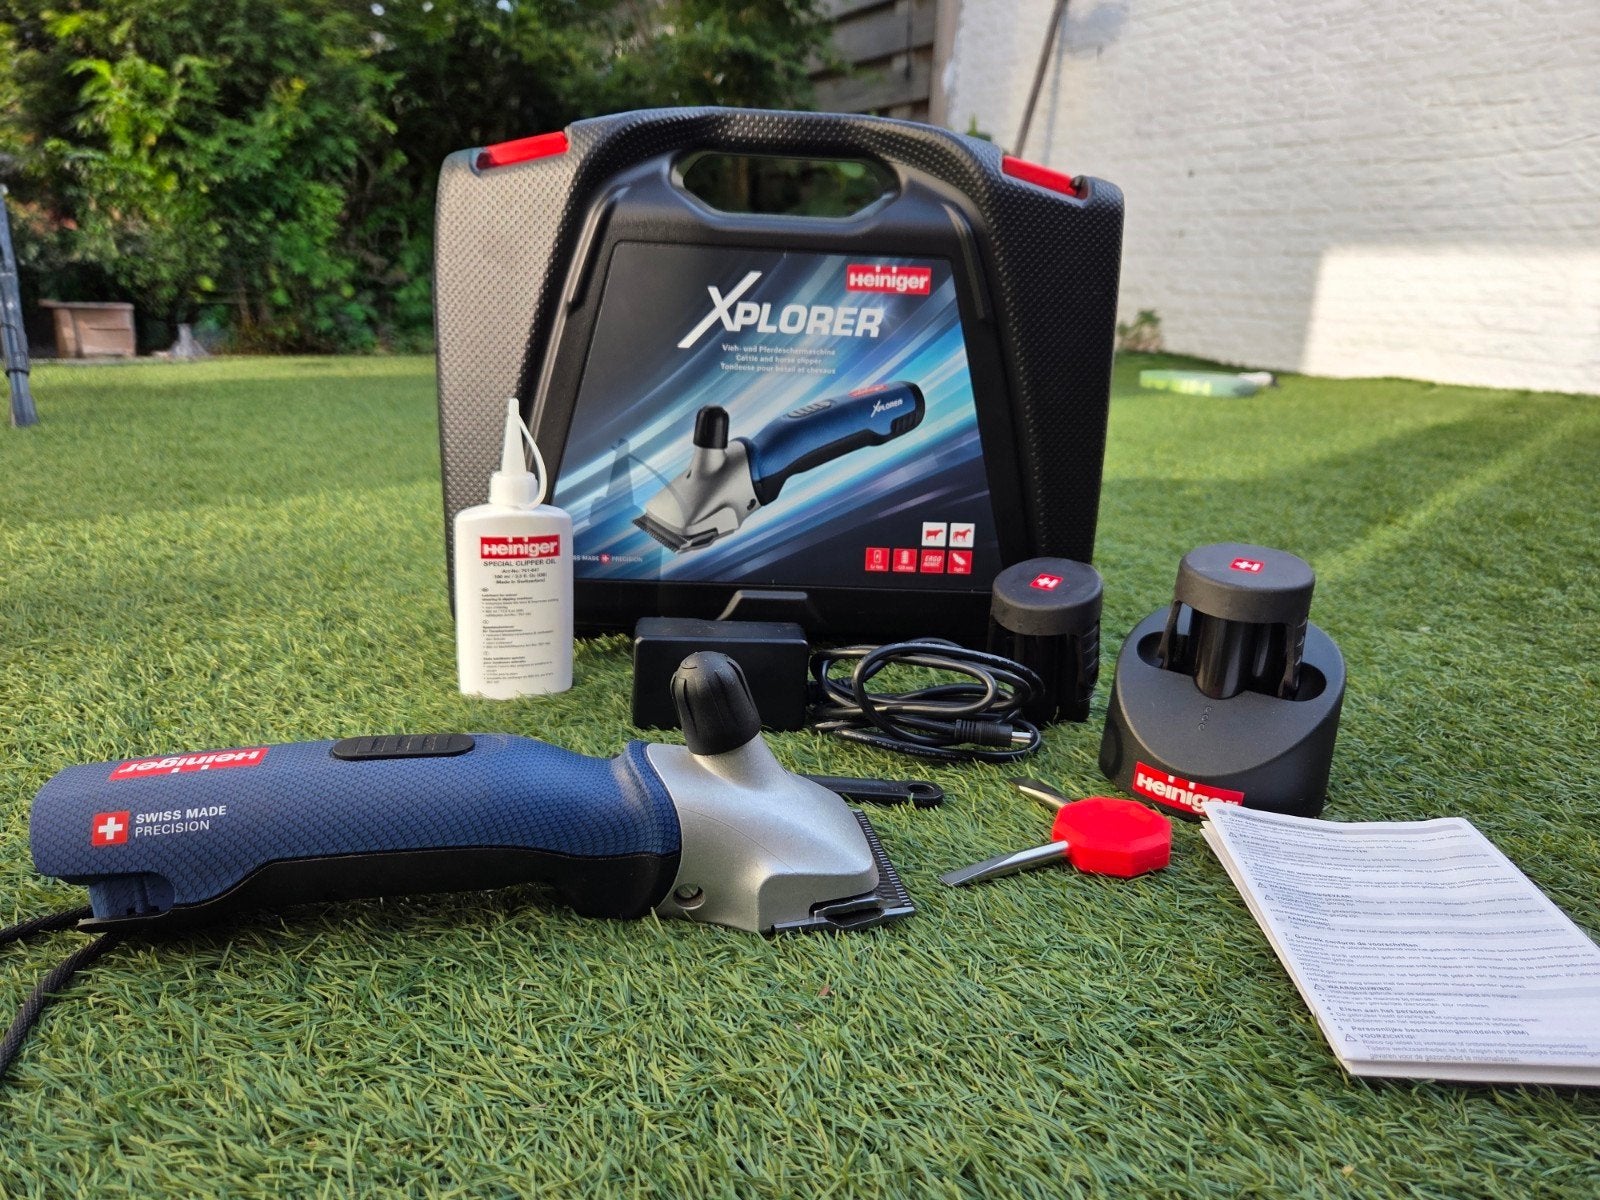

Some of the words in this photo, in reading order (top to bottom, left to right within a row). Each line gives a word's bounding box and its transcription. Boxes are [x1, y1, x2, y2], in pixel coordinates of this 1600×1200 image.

[849, 266, 929, 291] Heiniger
[677, 271, 885, 349] XPLORER
[483, 537, 558, 556] Heiniger
[118, 751, 260, 774] Heiniger
[136, 810, 182, 824] SWISS
[186, 805, 226, 819] MADE
[135, 820, 210, 838] PRECISION
